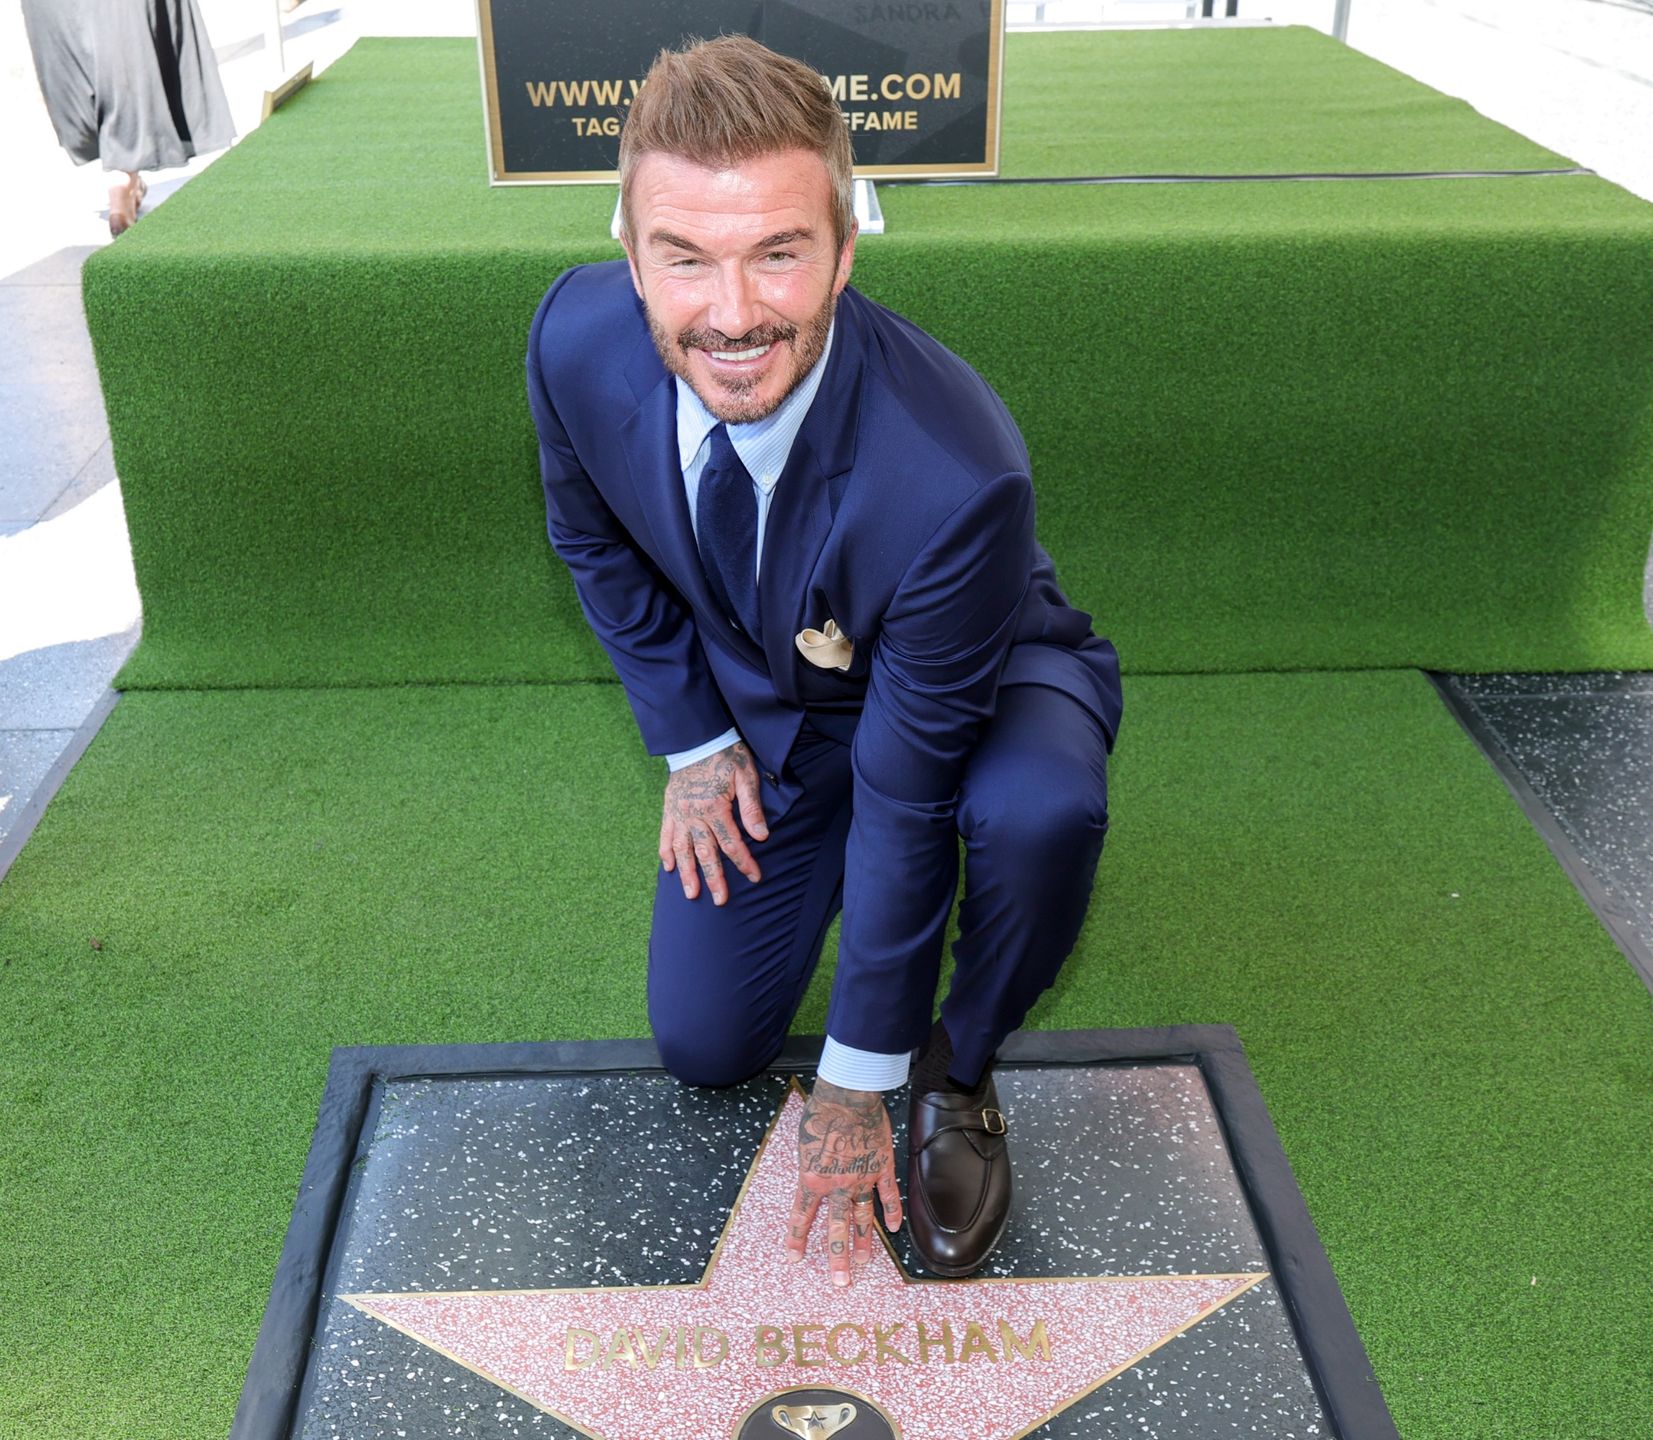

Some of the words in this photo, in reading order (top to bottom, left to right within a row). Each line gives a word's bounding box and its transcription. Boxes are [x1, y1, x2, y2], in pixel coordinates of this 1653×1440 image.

[853, 3, 961, 24] SANDRA
[571, 117, 620, 137] TAG
[564, 1325, 729, 1371] DAVID
[754, 1318, 1052, 1369] BECKHAM
